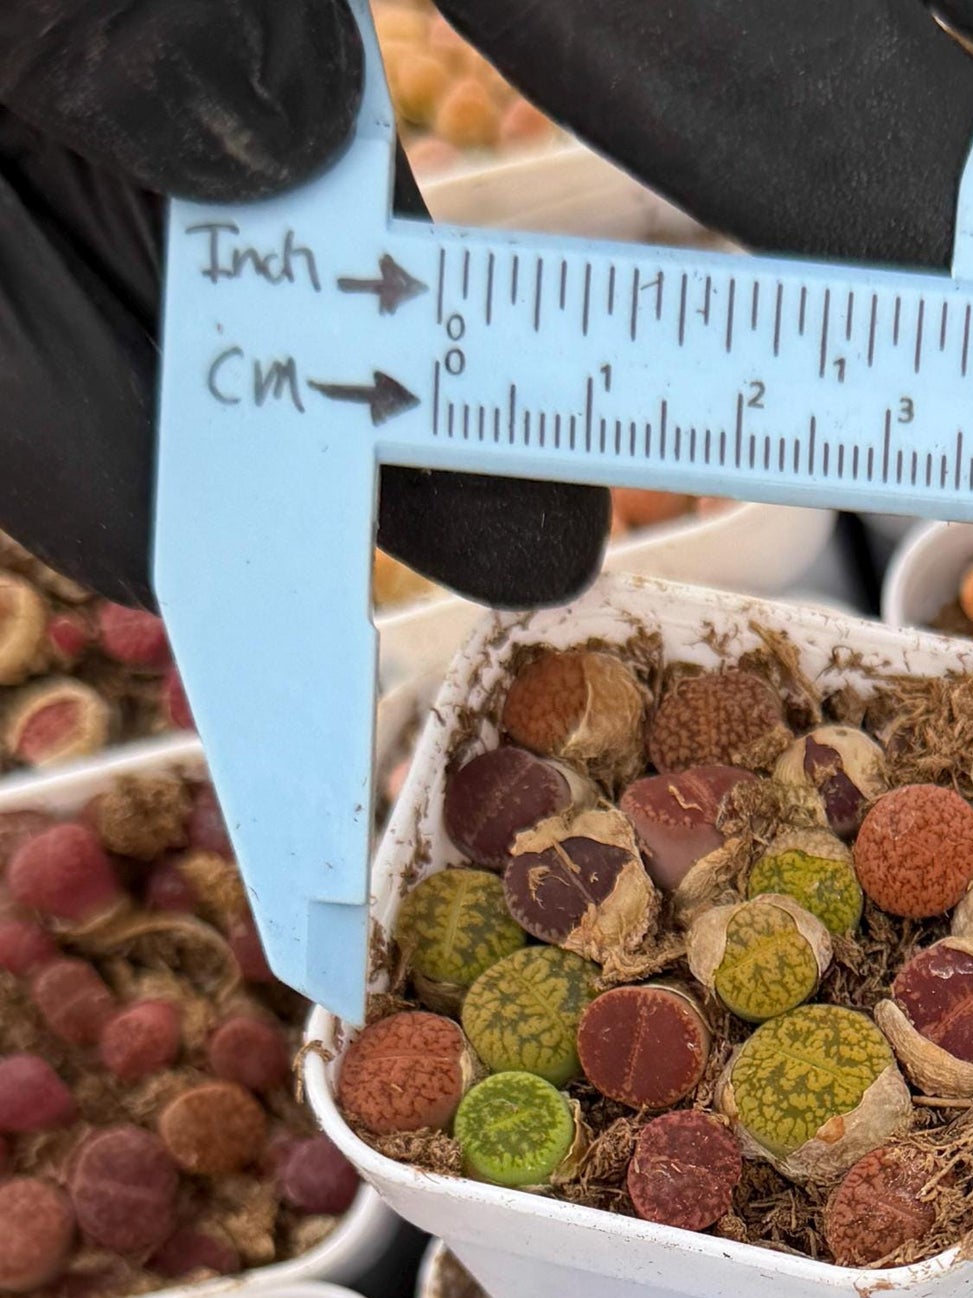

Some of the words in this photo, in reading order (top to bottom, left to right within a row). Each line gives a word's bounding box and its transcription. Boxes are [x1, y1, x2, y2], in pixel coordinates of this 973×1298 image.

[185, 221, 321, 293] Inch
[446, 312, 466, 342] 0
[832, 356, 846, 383] 1
[444, 347, 466, 376] 0
[600, 363, 613, 393] 1
[746, 380, 766, 409] 2
[897, 397, 915, 424] 3
